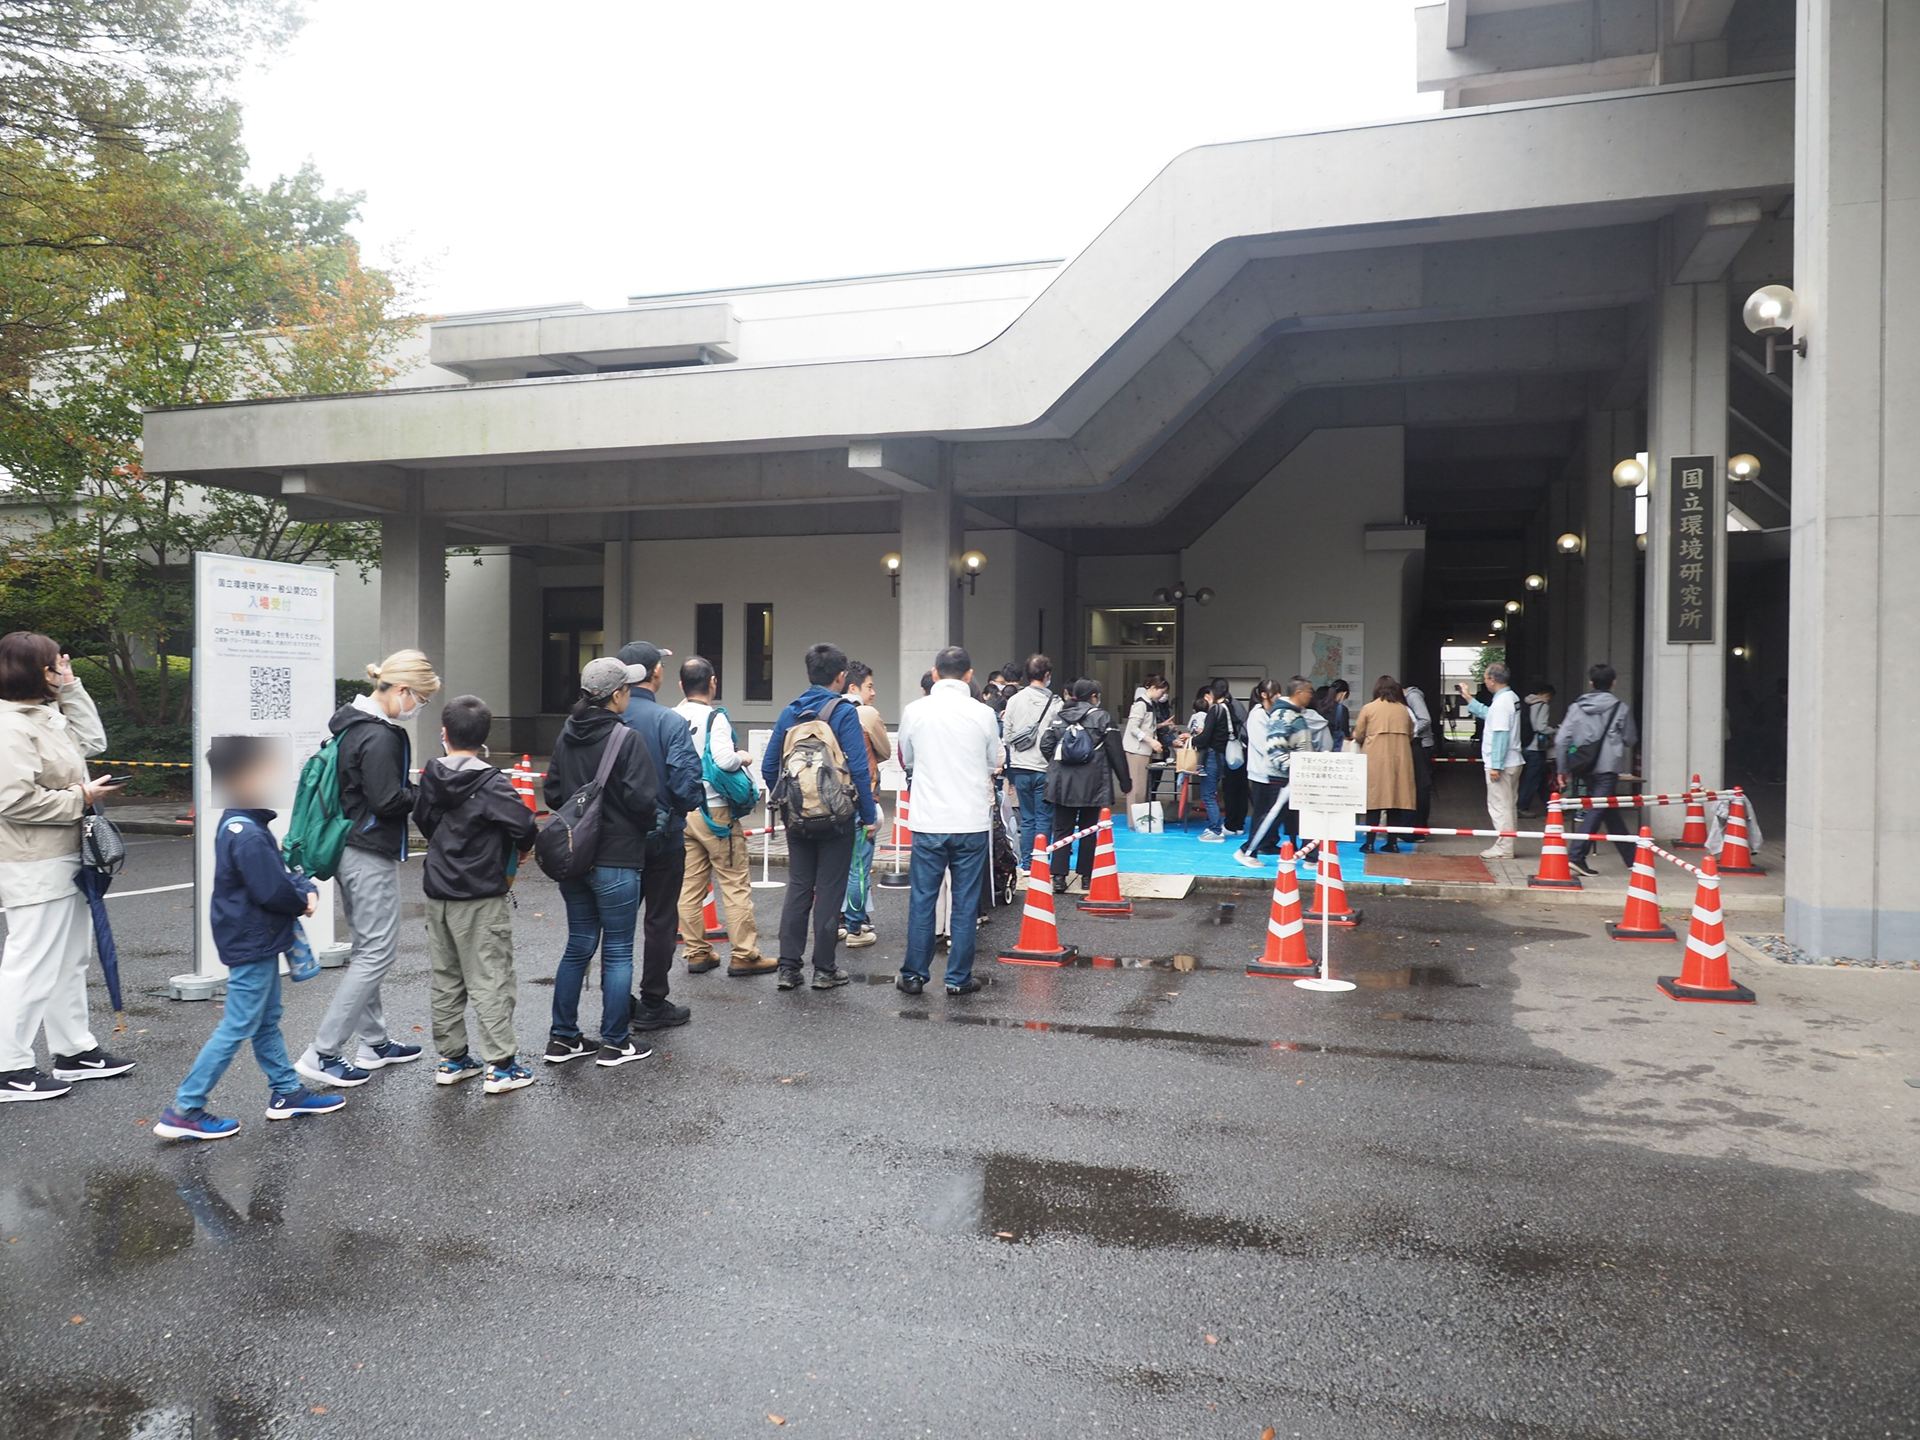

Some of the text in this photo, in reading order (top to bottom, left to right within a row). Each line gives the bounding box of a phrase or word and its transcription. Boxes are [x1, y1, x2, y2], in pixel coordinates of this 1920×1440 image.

[1678, 468, 1704, 629] 国立環境研究所
[217, 578, 318, 597] 国立環境研究所一般公開2025
[248, 595, 292, 612] 入場受付
